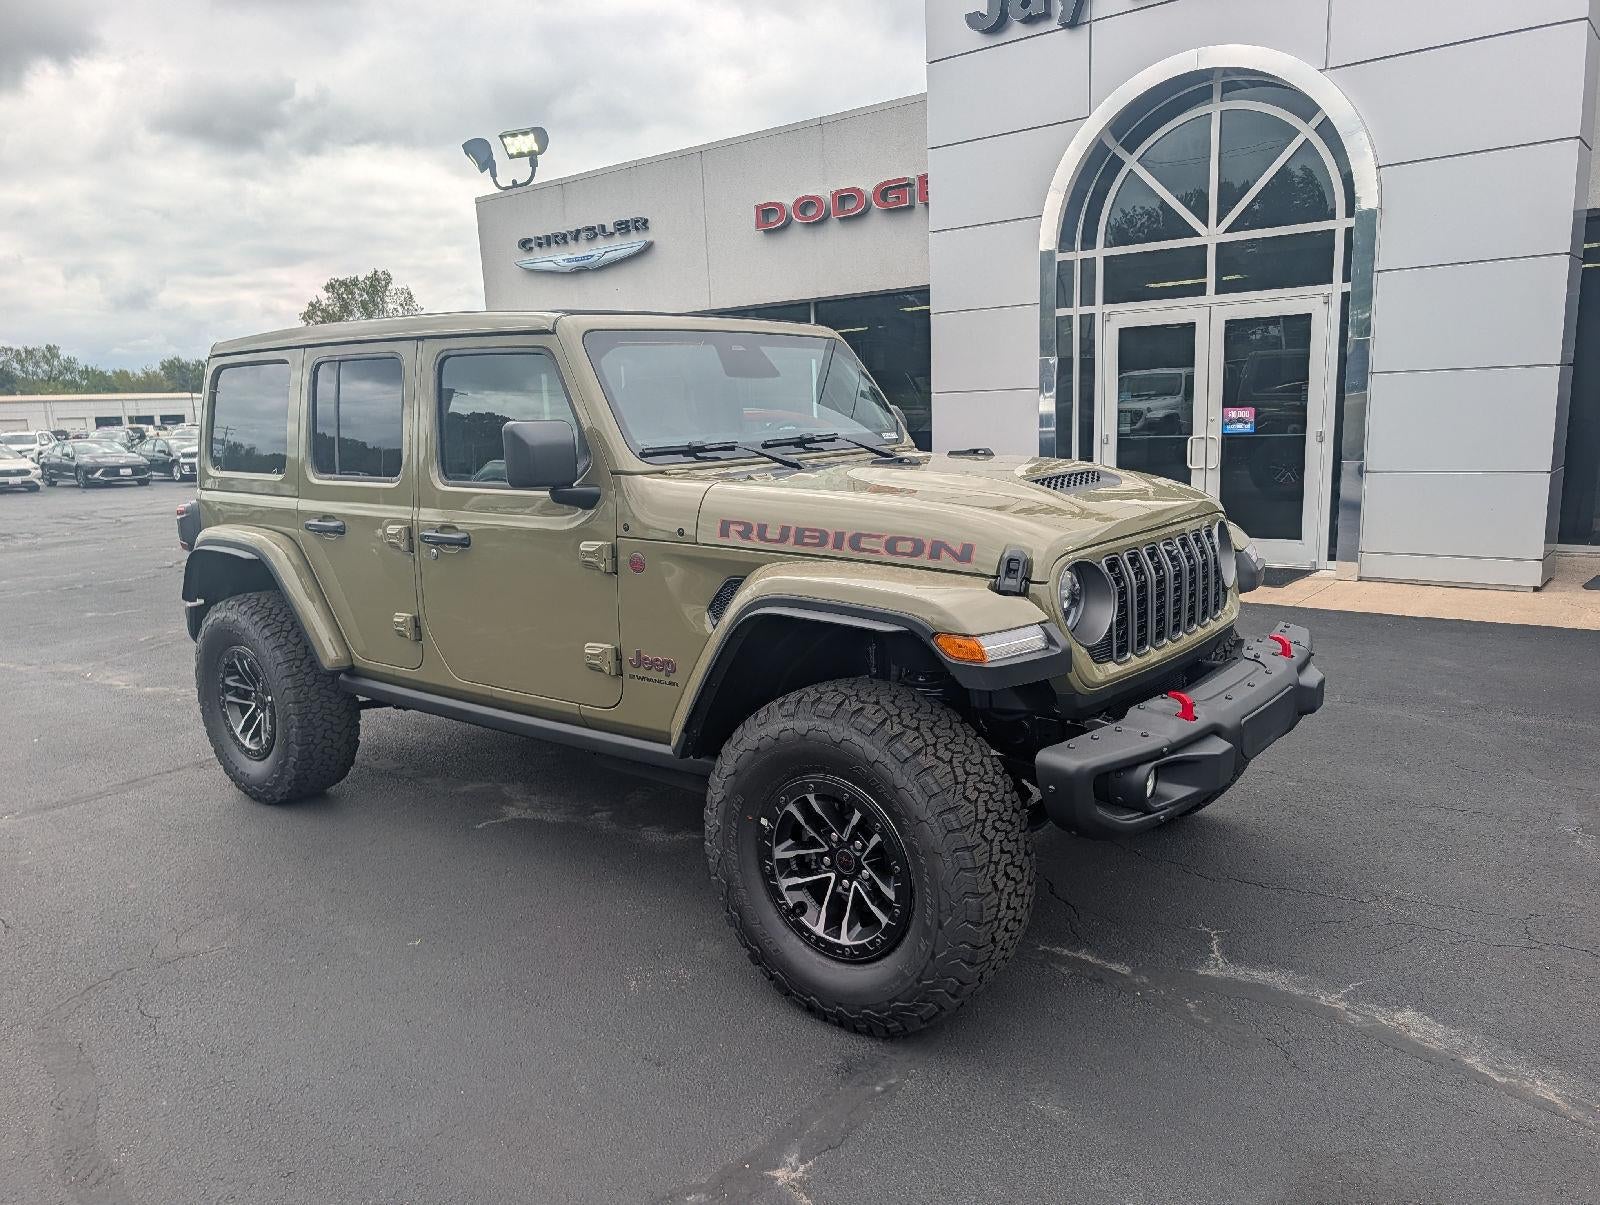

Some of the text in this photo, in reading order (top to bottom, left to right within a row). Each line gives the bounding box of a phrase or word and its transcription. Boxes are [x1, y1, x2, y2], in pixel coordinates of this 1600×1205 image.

[517, 216, 649, 251] CHRYSLER
[718, 518, 976, 564] RUBICON
[628, 648, 677, 677] Jeep
